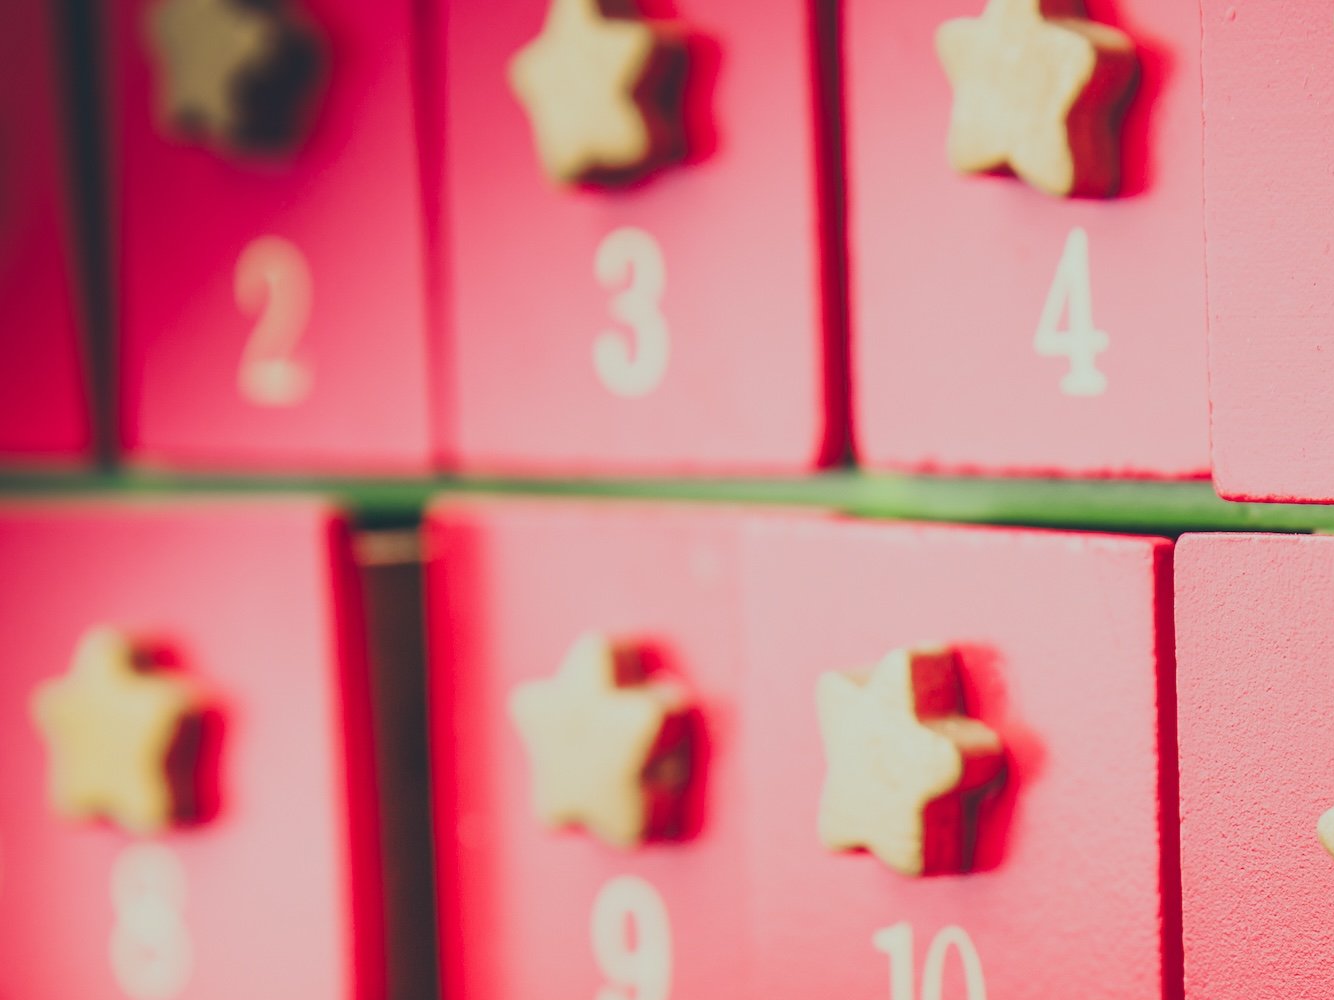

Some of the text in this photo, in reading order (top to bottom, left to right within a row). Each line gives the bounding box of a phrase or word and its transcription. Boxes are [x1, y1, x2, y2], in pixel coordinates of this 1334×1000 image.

[234, 237, 312, 406] 2
[592, 228, 670, 399] 3
[1036, 230, 1108, 400] 4
